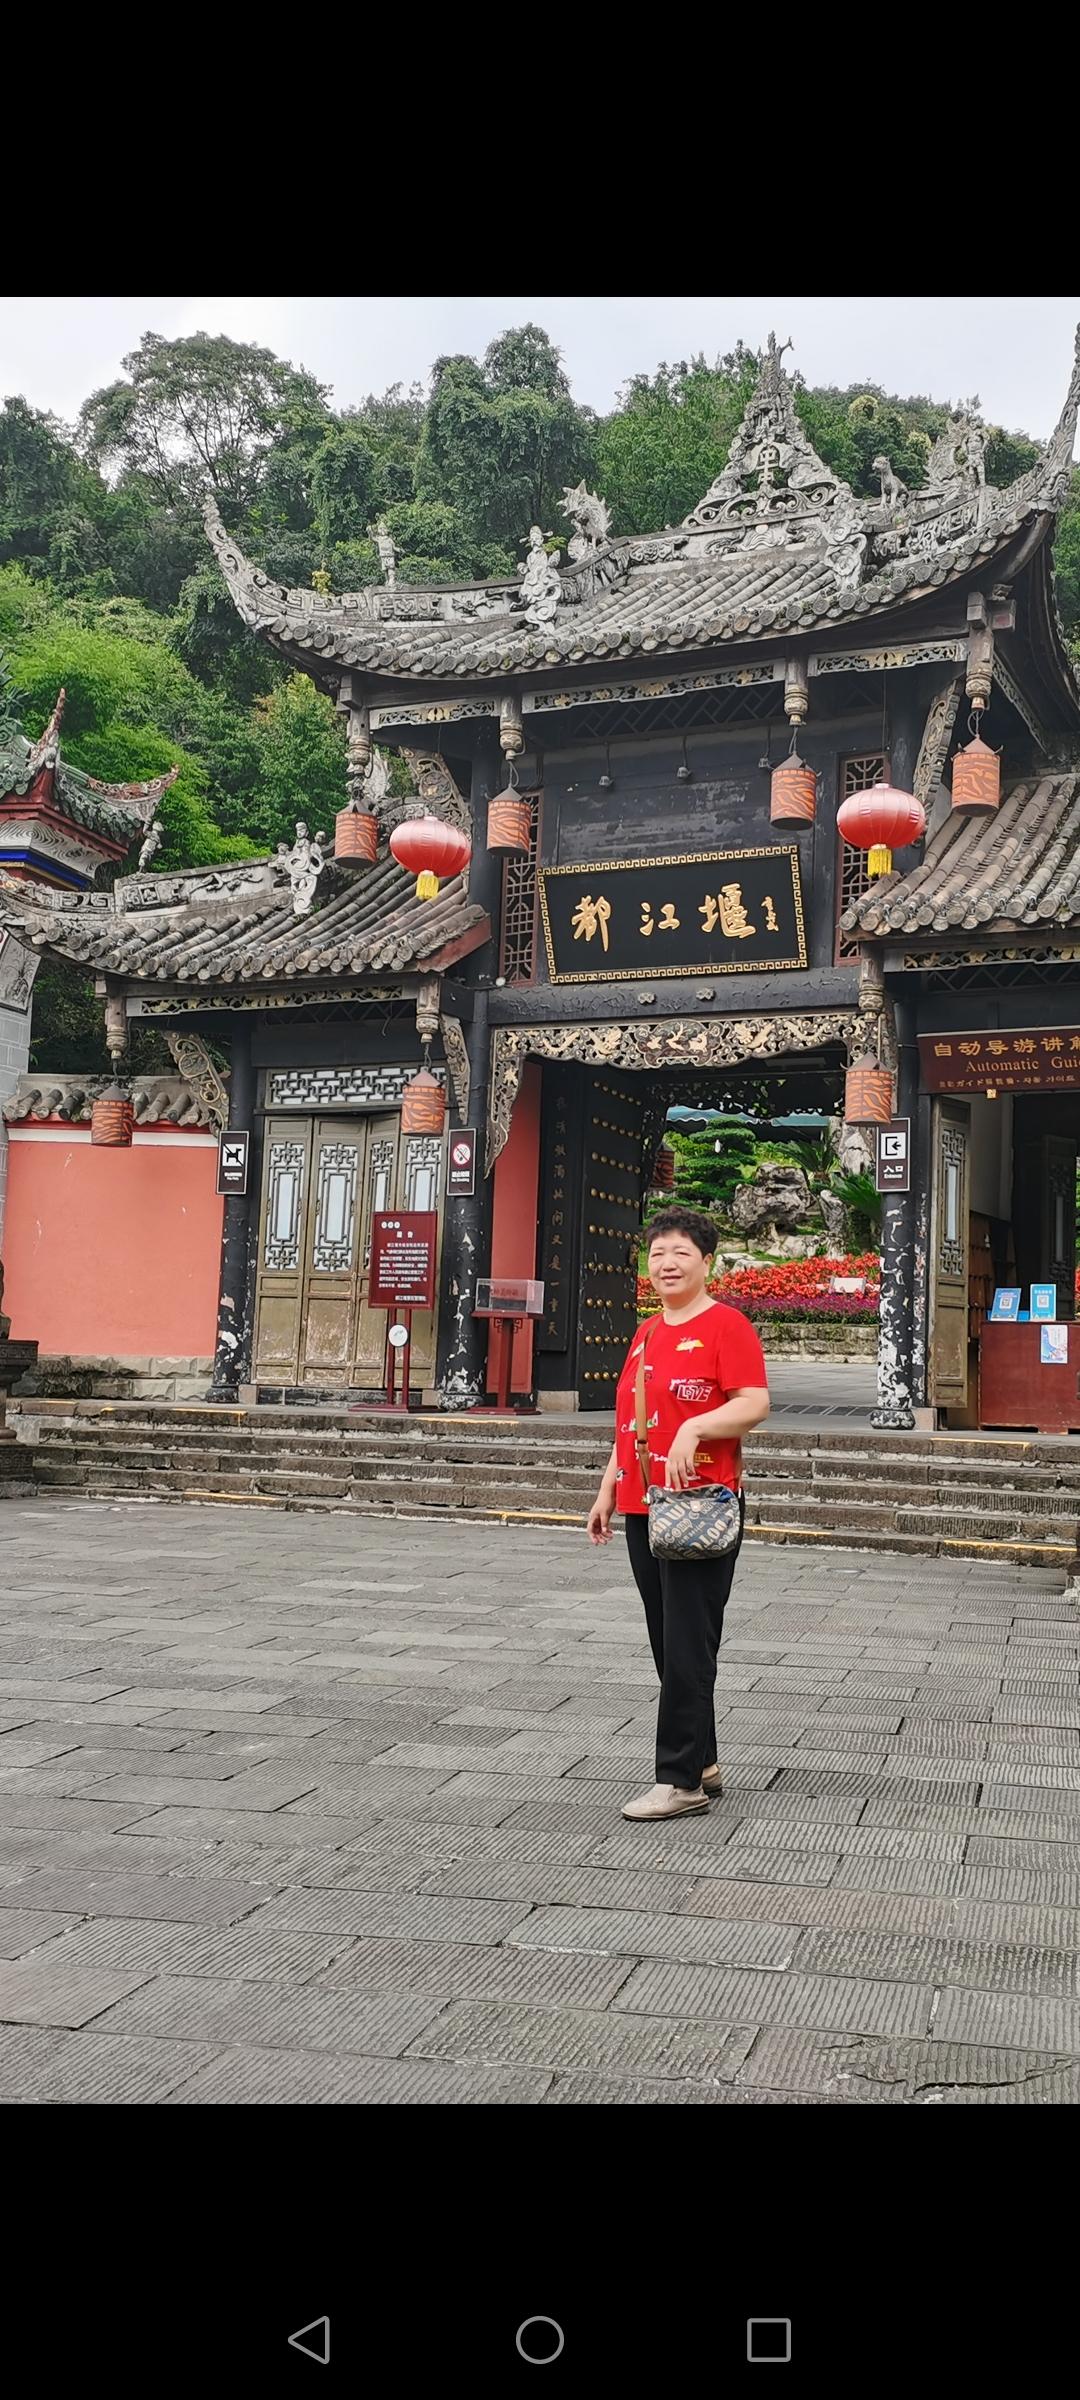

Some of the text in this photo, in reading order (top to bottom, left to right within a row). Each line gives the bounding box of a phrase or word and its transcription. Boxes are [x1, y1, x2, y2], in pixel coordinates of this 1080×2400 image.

[571, 882, 757, 952] 都江堰
[966, 1058, 1040, 1072] Automatic
[883, 1165, 904, 1173] 入口
